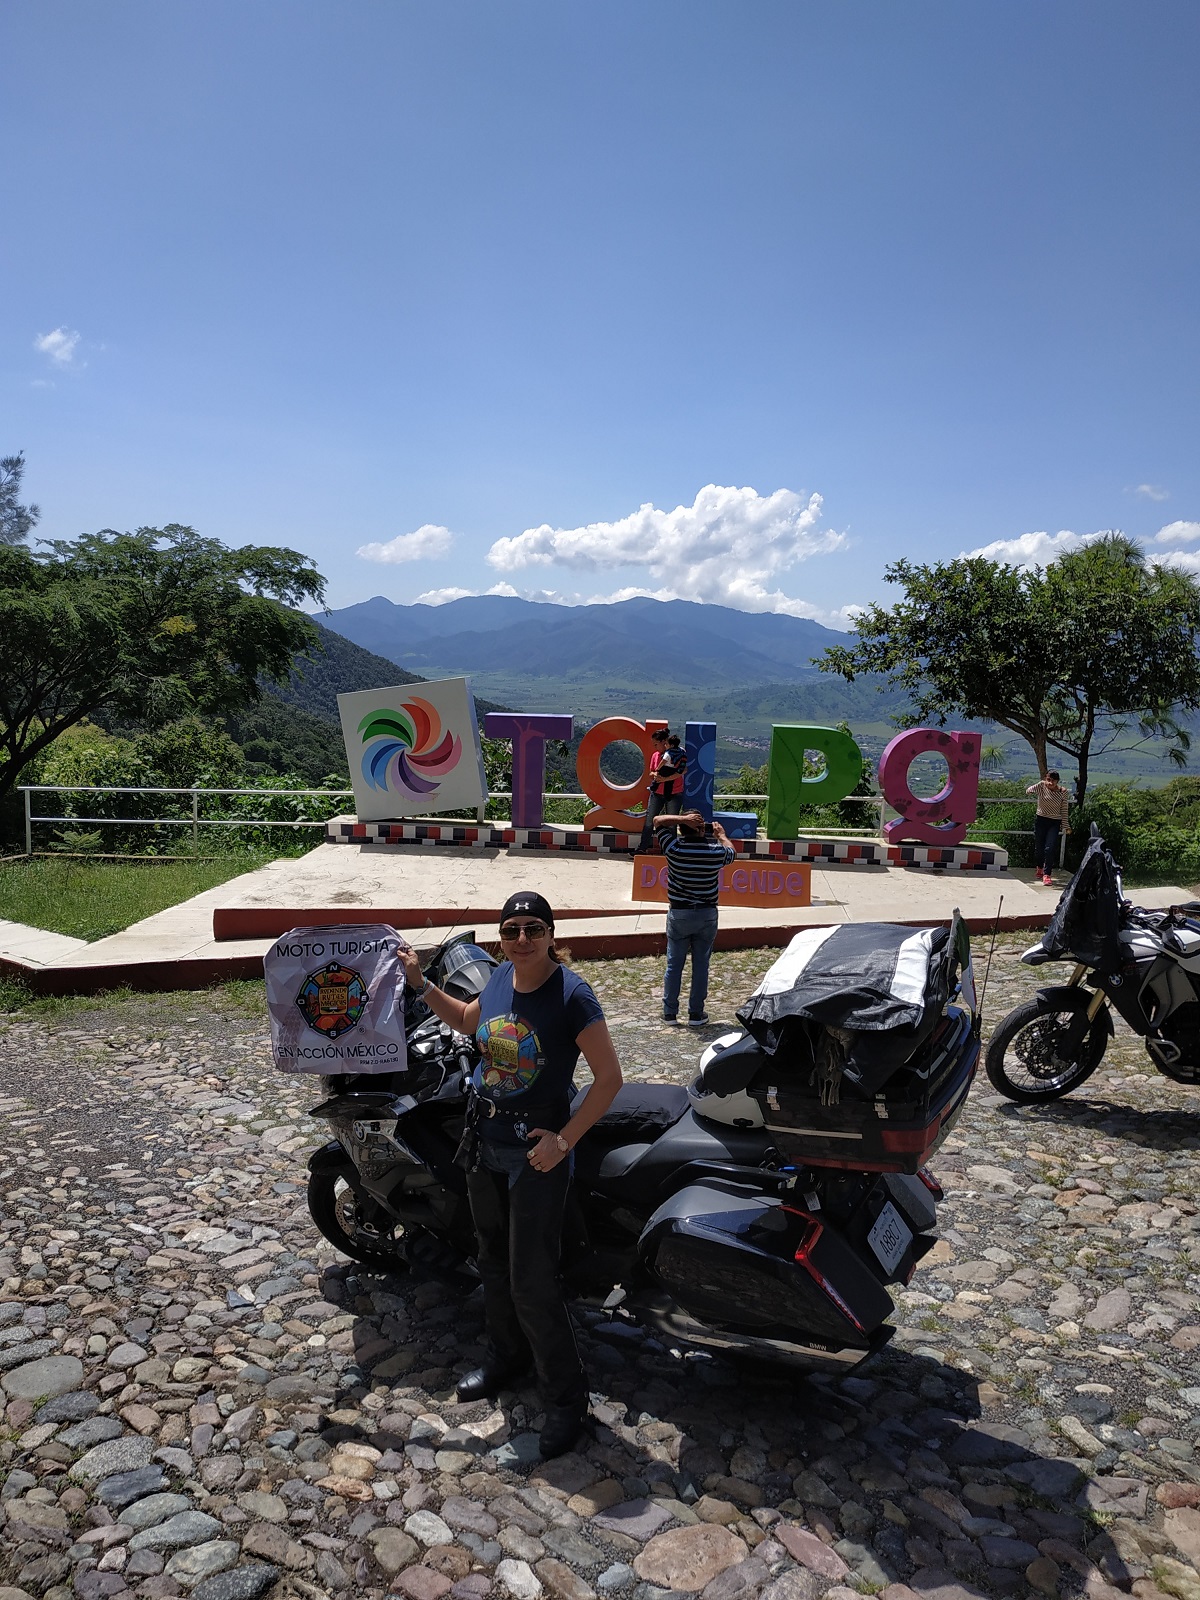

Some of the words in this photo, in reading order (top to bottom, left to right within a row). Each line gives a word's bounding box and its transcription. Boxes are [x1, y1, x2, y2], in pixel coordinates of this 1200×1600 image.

[276, 943, 325, 958] MOTO
[329, 939, 390, 956] TURISTA
[508, 1013, 518, 1021] N
[278, 1046, 294, 1058] EN
[298, 1044, 344, 1059] ACCIÓN
[347, 1042, 399, 1058] MÉXICO
[879, 1217, 903, 1258] A8BC7
[809, 1342, 827, 1351] BMW
